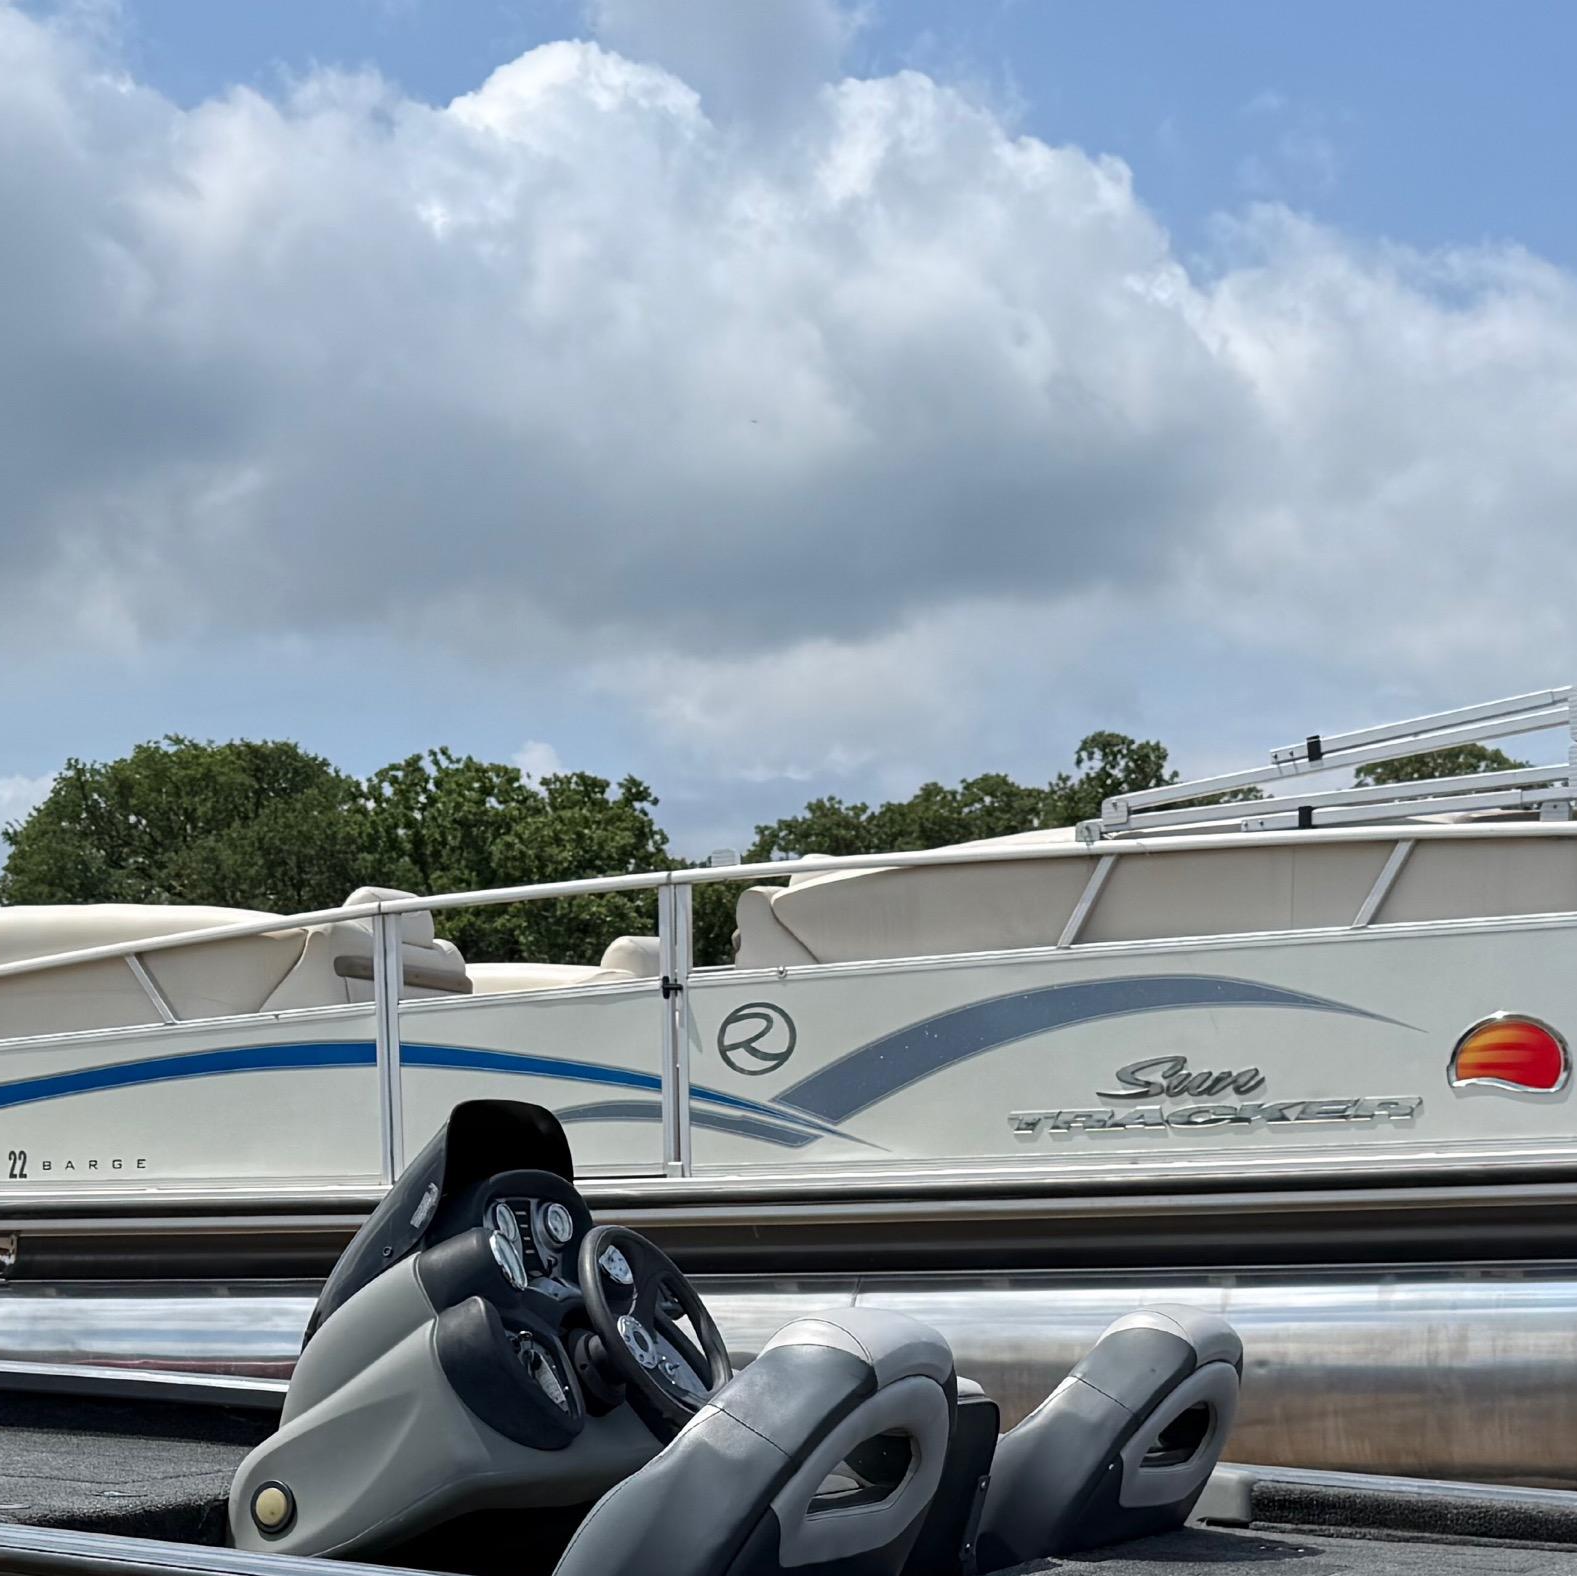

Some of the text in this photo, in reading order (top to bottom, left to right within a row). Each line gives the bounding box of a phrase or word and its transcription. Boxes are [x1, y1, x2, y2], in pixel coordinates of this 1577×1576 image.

[1095, 1055, 1266, 1099] Sun
[1006, 1095, 1423, 1135] TRACKER
[8, 1150, 28, 1179] 22
[41, 1158, 147, 1172] BARGE
